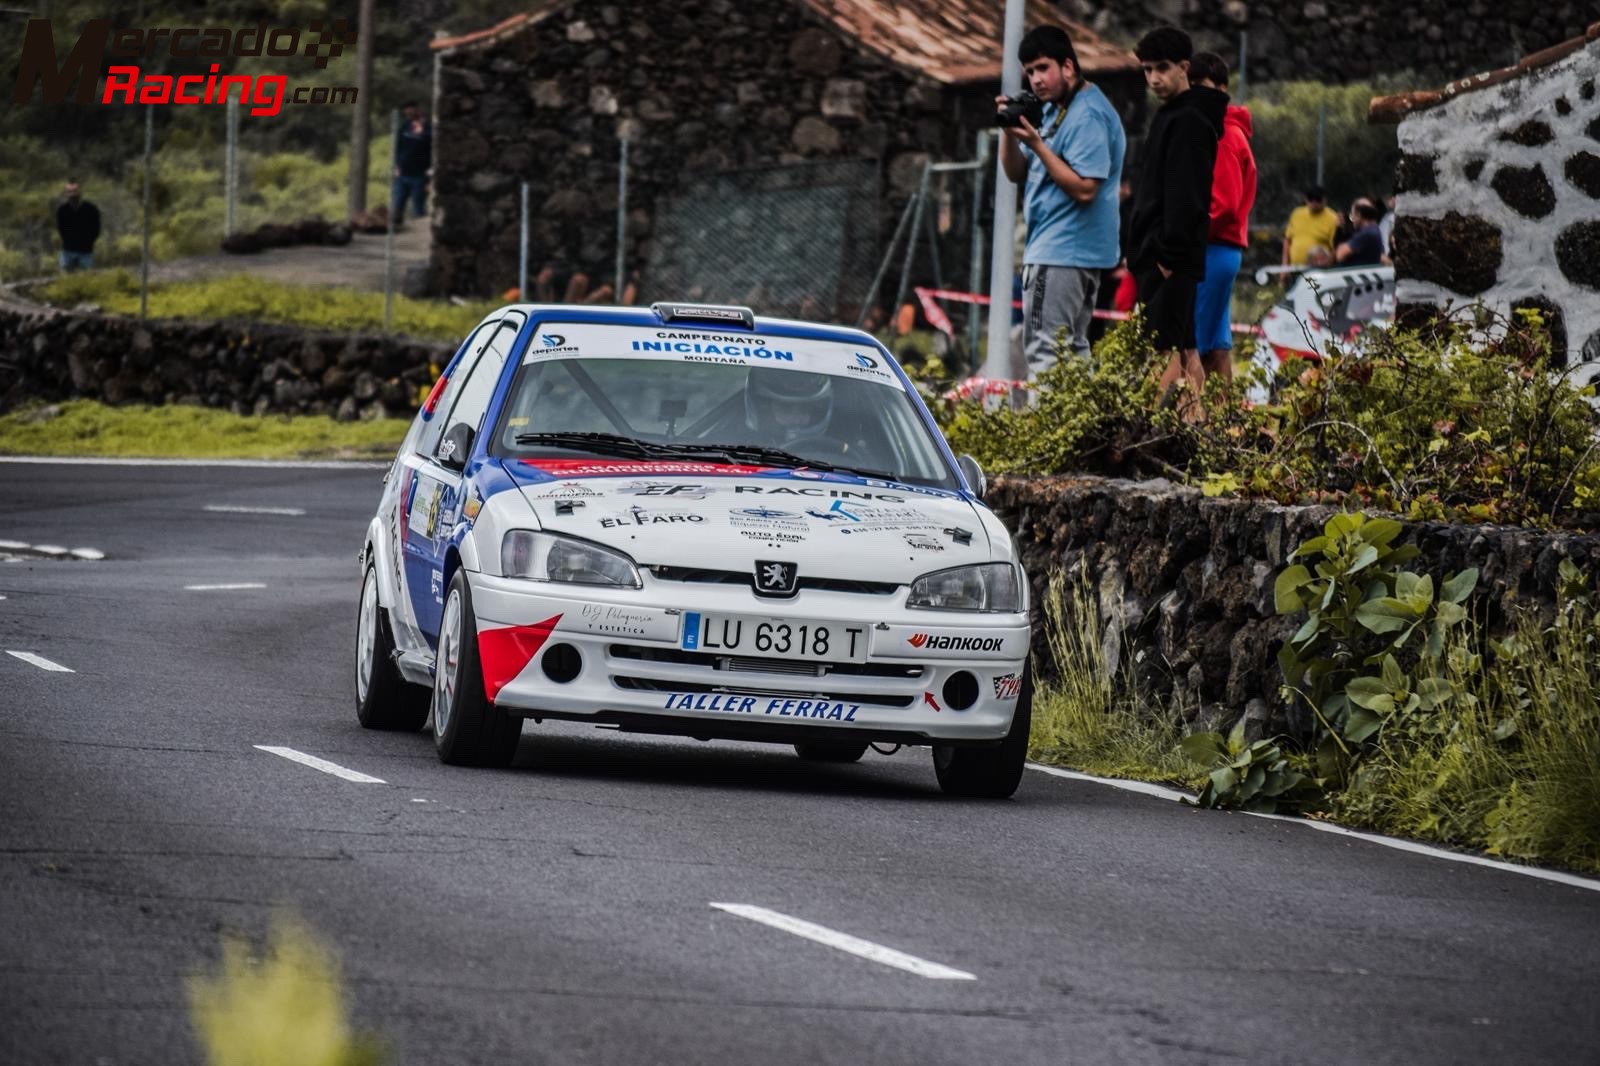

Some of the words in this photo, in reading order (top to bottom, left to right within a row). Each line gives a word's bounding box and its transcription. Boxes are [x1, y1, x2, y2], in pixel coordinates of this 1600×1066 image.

[656, 332, 766, 346] CAMPEONATO
[532, 346, 579, 354] deportes
[632, 340, 794, 362] INICIACIÓN
[684, 355, 746, 364] MONTAÑA
[847, 365, 891, 378] deportes
[735, 485, 905, 503] RACING
[600, 517, 631, 528] EL
[632, 507, 704, 525] FARO
[599, 624, 645, 634] ESTETICA
[687, 634, 695, 644] E
[703, 617, 742, 649] LU
[755, 622, 830, 656] 6318
[845, 627, 863, 658] T
[664, 693, 757, 713] TALLER
[765, 699, 860, 722] FERRAZ
